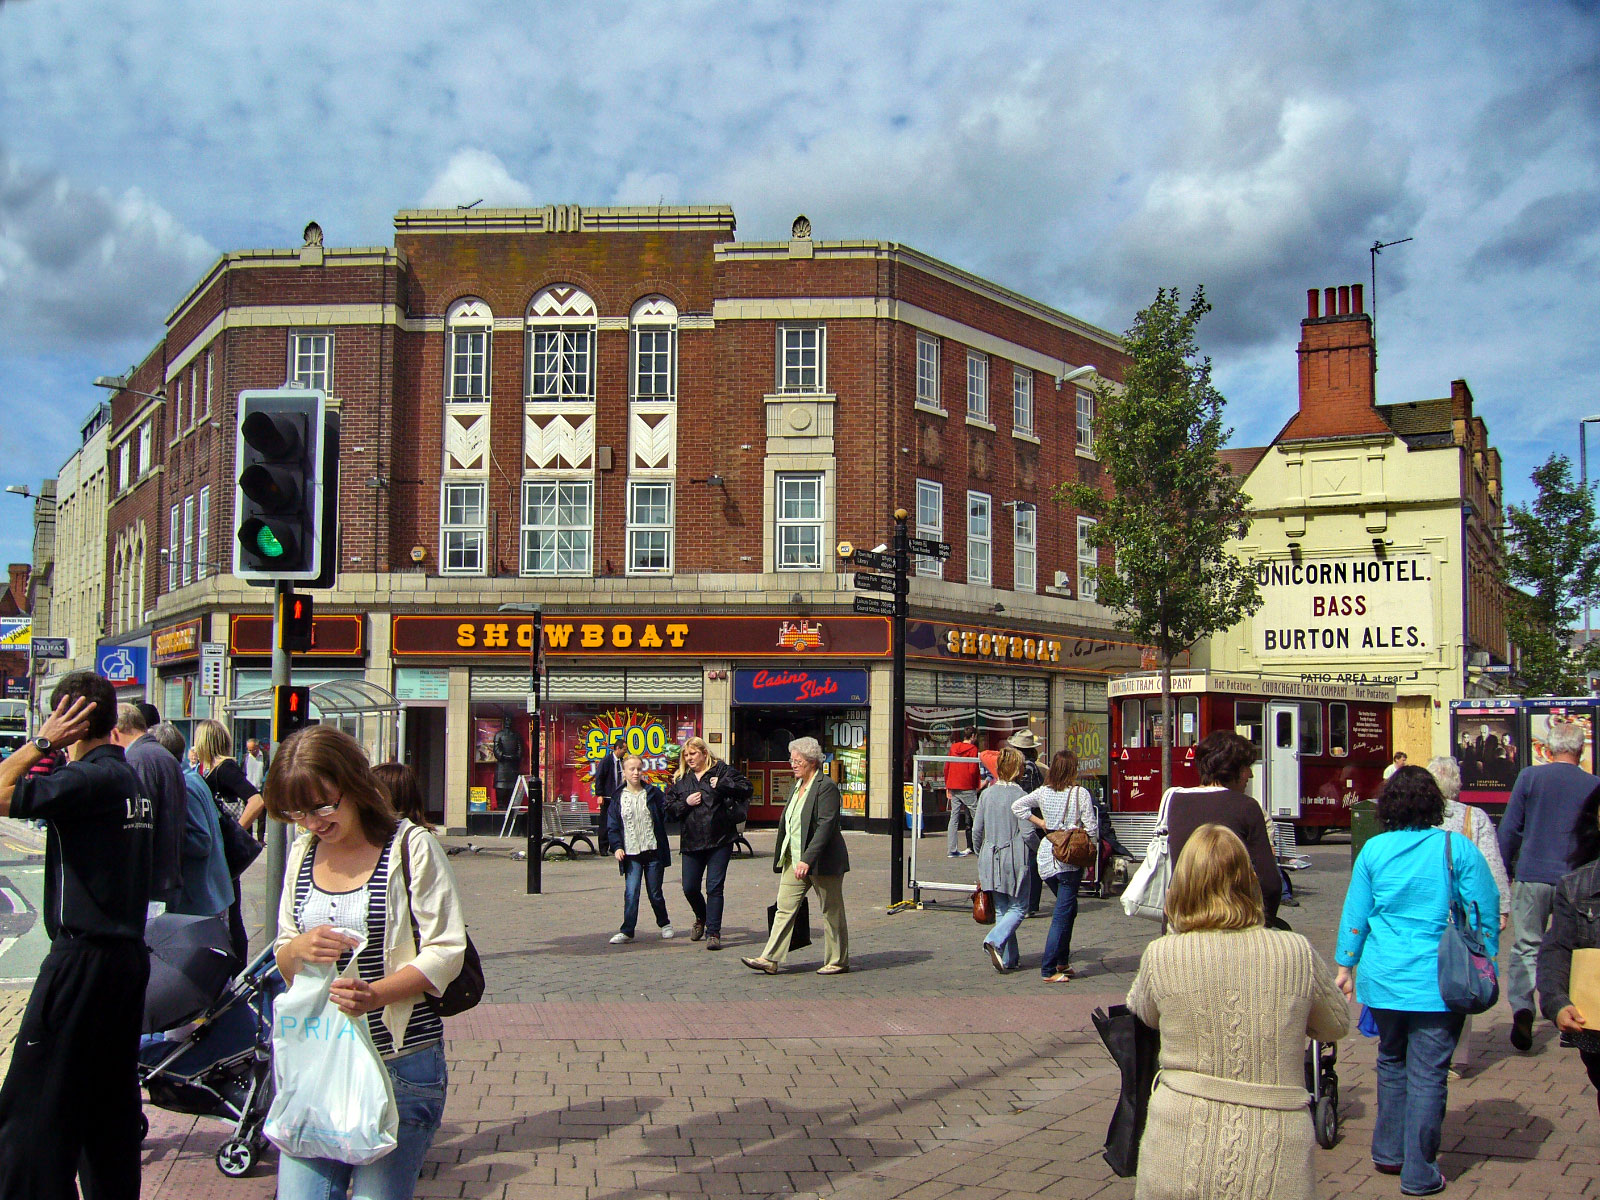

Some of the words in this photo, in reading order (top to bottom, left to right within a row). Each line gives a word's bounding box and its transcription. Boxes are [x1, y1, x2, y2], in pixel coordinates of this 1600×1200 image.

[1258, 562, 1347, 586] UNICORN
[1353, 560, 1431, 583] HOTEL.
[1313, 595, 1367, 617] BASS
[457, 623, 688, 648] SHOWBOAT
[947, 630, 1061, 662] SHOWBOAT
[1265, 628, 1349, 650] BURTON
[1362, 626, 1426, 648] ALES.
[753, 669, 808, 689] Casino
[795, 677, 838, 701] Slots
[1136, 679, 1153, 691] TRAM
[1157, 678, 1192, 690] CPANY
[1214, 679, 1225, 689] Hot
[1227, 680, 1252, 691] Potatoes
[1262, 681, 1300, 695] CHURCHGATE
[1303, 684, 1318, 696] TRAM
[1321, 686, 1347, 697] COMPANY
[1356, 688, 1365, 697] Hot
[1367, 689, 1389, 699] Potatoes
[1301, 673, 1332, 683] PATIO
[1337, 673, 1367, 683] AREA
[1384, 675, 1402, 683] rear
[846, 711, 866, 719] FROM
[586, 724, 667, 760] £500
[831, 722, 864, 748] 10p
[842, 794, 866, 809] DAY
